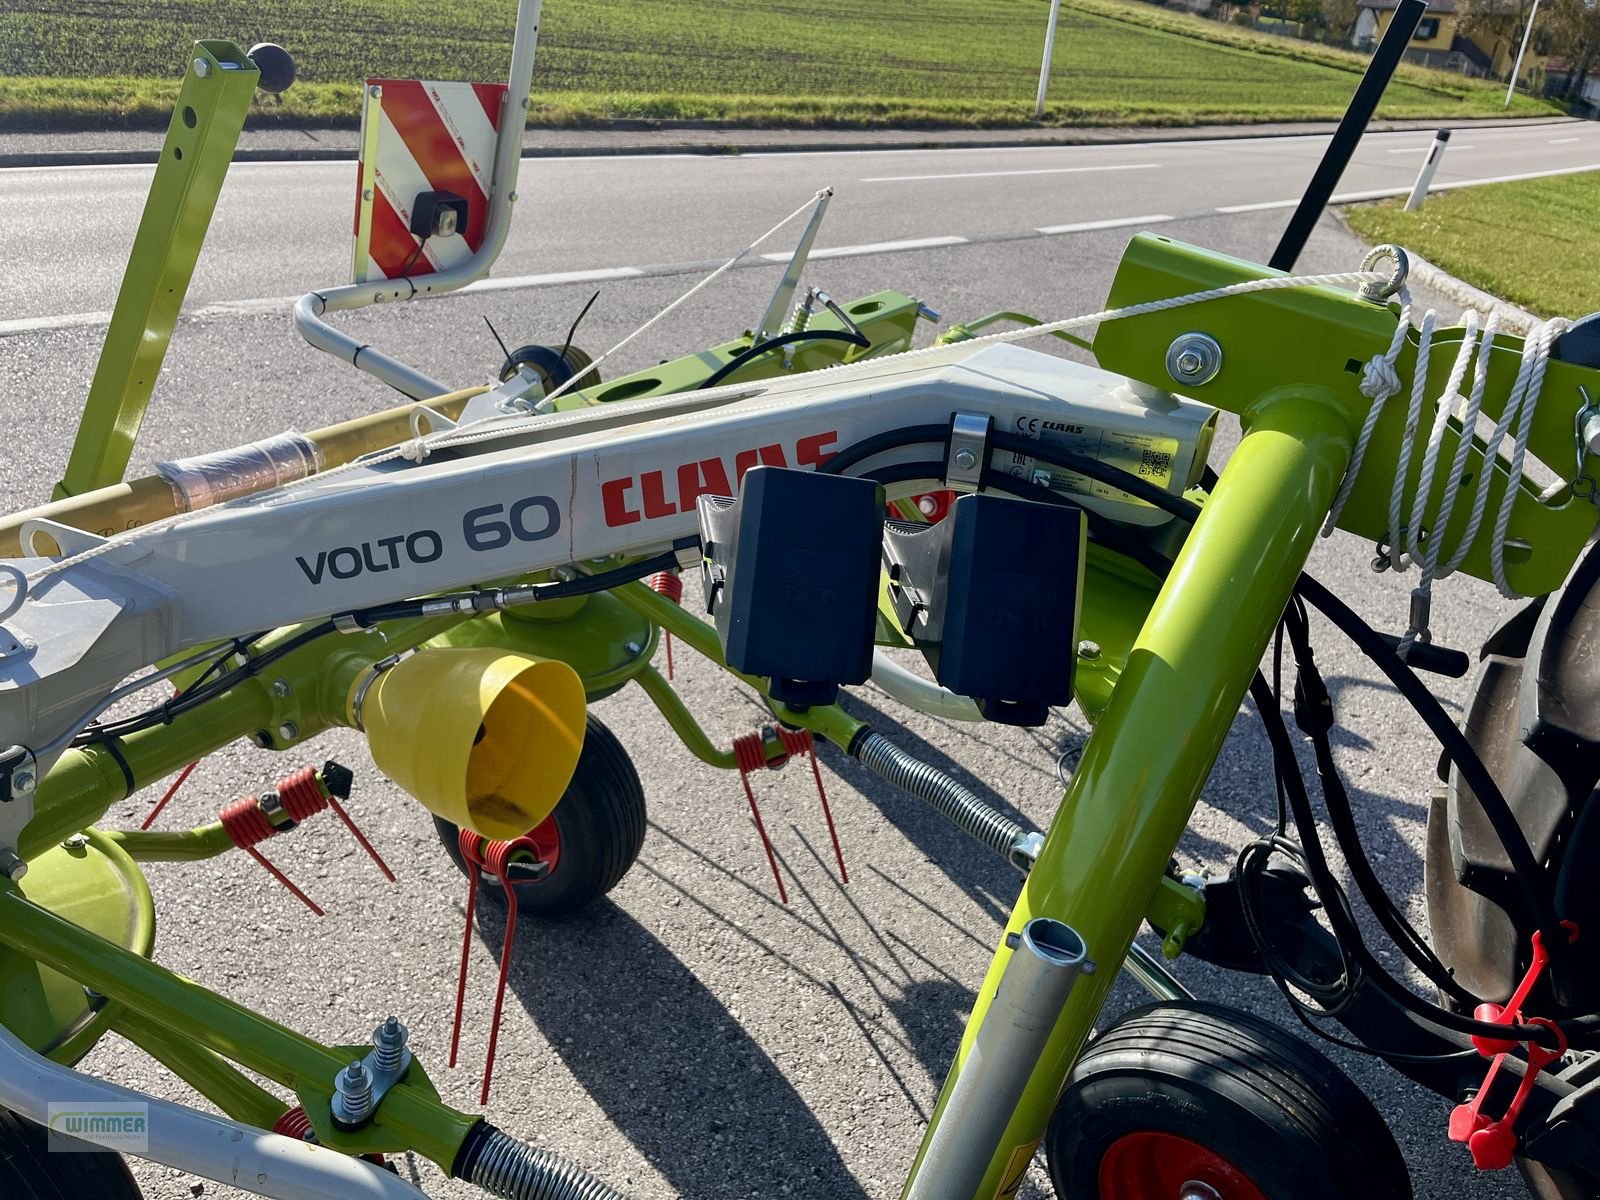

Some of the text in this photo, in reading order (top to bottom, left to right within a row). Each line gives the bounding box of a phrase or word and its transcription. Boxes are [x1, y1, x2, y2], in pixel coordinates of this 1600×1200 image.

[1041, 421, 1084, 434] CLAAS
[295, 495, 561, 585] VOLTO 60
